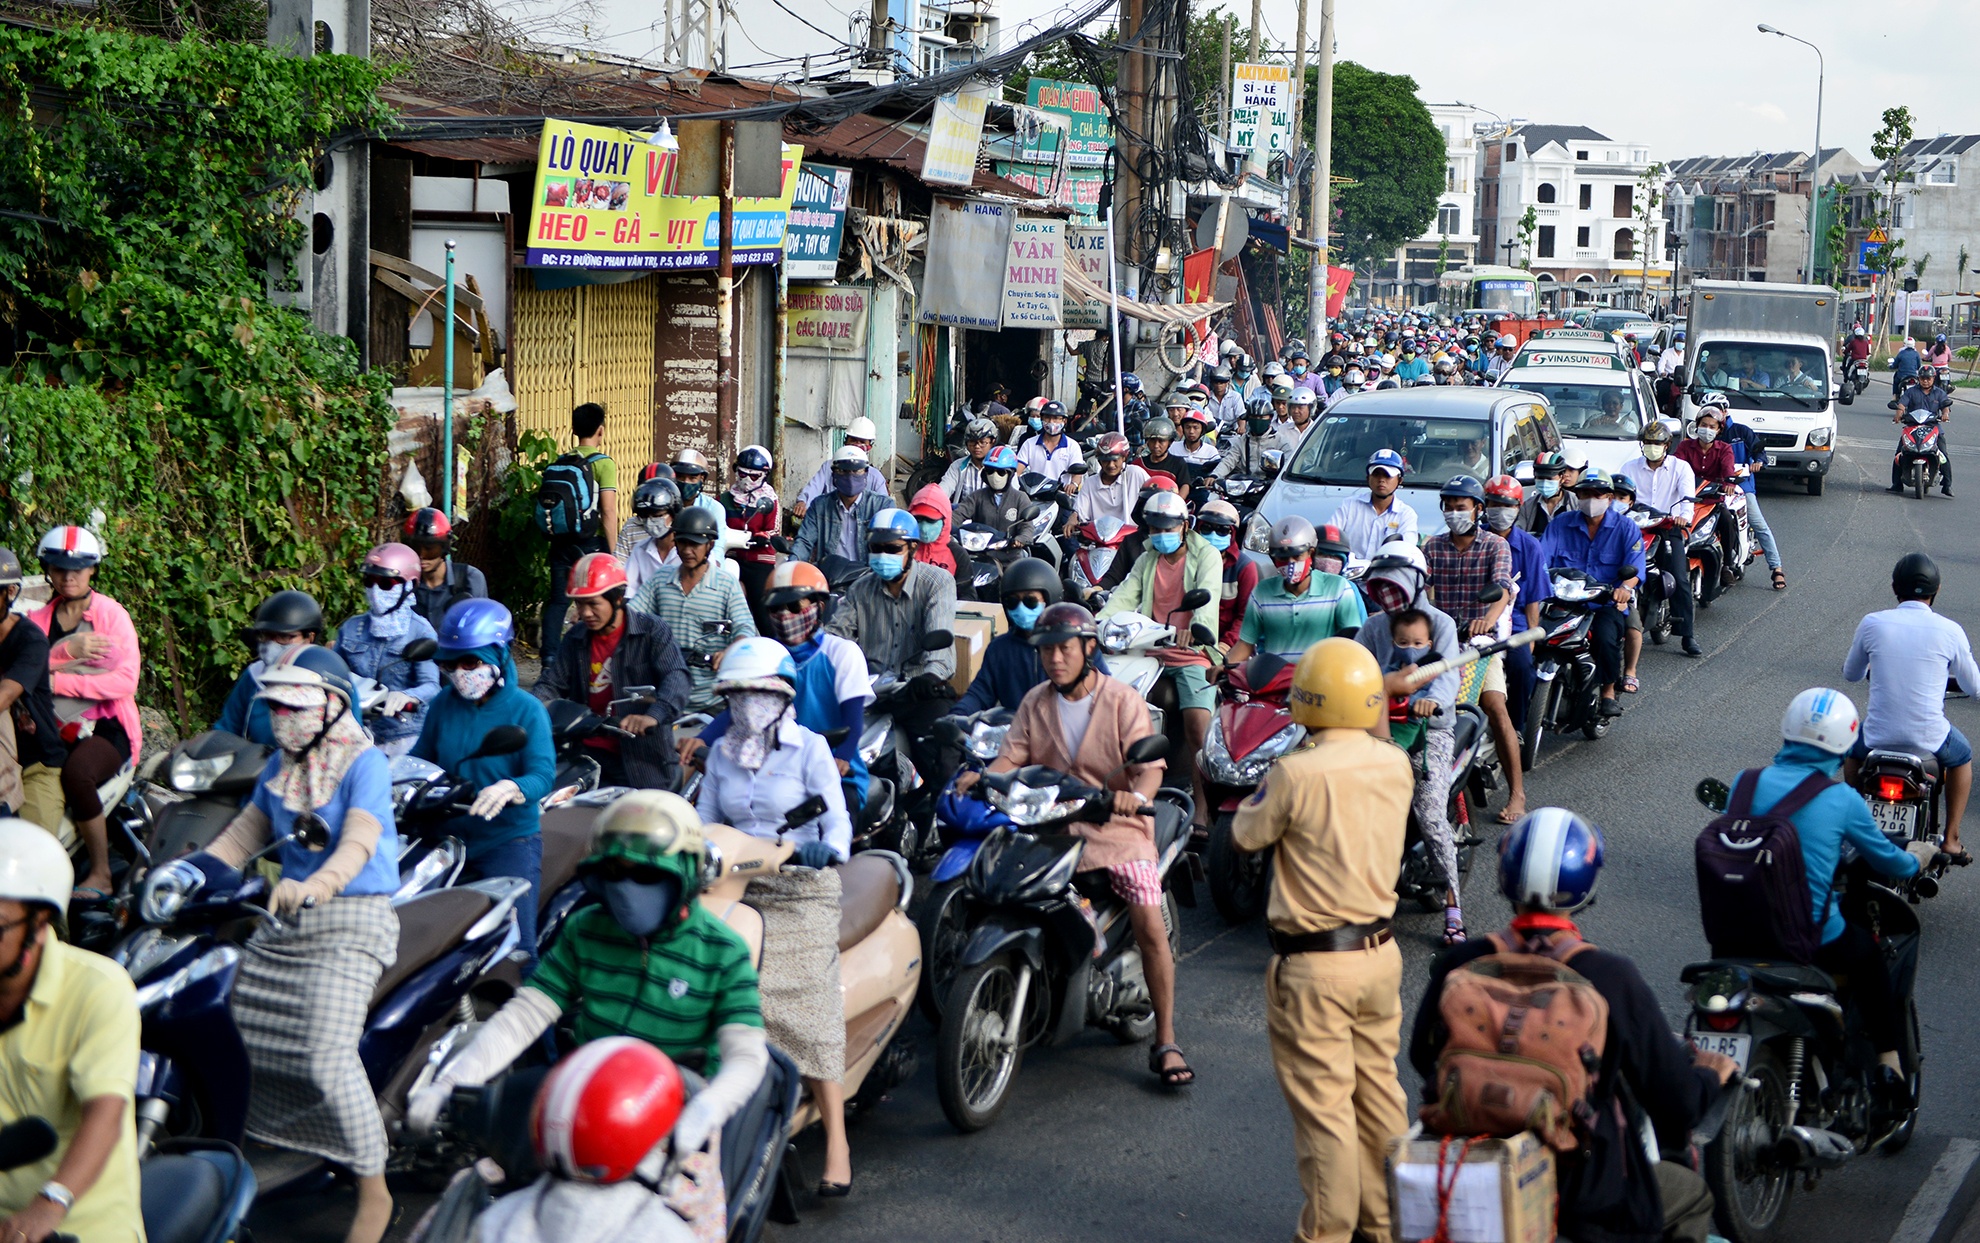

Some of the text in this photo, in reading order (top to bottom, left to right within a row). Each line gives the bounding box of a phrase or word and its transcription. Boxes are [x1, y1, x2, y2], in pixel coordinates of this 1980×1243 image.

[1236, 64, 1288, 82] AKIYAMA
[1038, 82, 1059, 109] QUÁN
[1071, 86, 1096, 114] CHÍN
[1245, 94, 1276, 106] HÀNG
[1080, 118, 1093, 137] CHẢ
[1237, 128, 1254, 146] MỸ
[548, 129, 575, 170] LÒ
[579, 138, 634, 177] QUAY
[975, 202, 1002, 216] HÀNG
[538, 212, 588, 242] HEO
[613, 212, 640, 244] GÀ
[667, 220, 698, 250] VỊT
[1015, 221, 1037, 232] SỬA
[805, 234, 818, 255] TAY
[820, 235, 830, 255] GA
[1013, 236, 1054, 259] VÂN
[1089, 236, 1104, 250] XE
[542, 254, 558, 265] ĐC:
[560, 255, 571, 265] F2
[573, 253, 602, 266] ĐƯỜNG
[603, 256, 626, 266] PHAN
[627, 254, 644, 266] VĂN
[660, 256, 674, 268] P.5,
[694, 252, 709, 265] VẤP.
[748, 253, 761, 262] 623
[762, 252, 774, 262] 153
[1009, 266, 1057, 284] MINH
[787, 290, 863, 312] CHUYÊN SƠN SỬA
[1027, 302, 1038, 310] Tay
[923, 310, 997, 326] ỐNG NHỰA BÌNH MINH
[1021, 312, 1029, 320] Số
[796, 317, 851, 340] CÁC LOẠI XE
